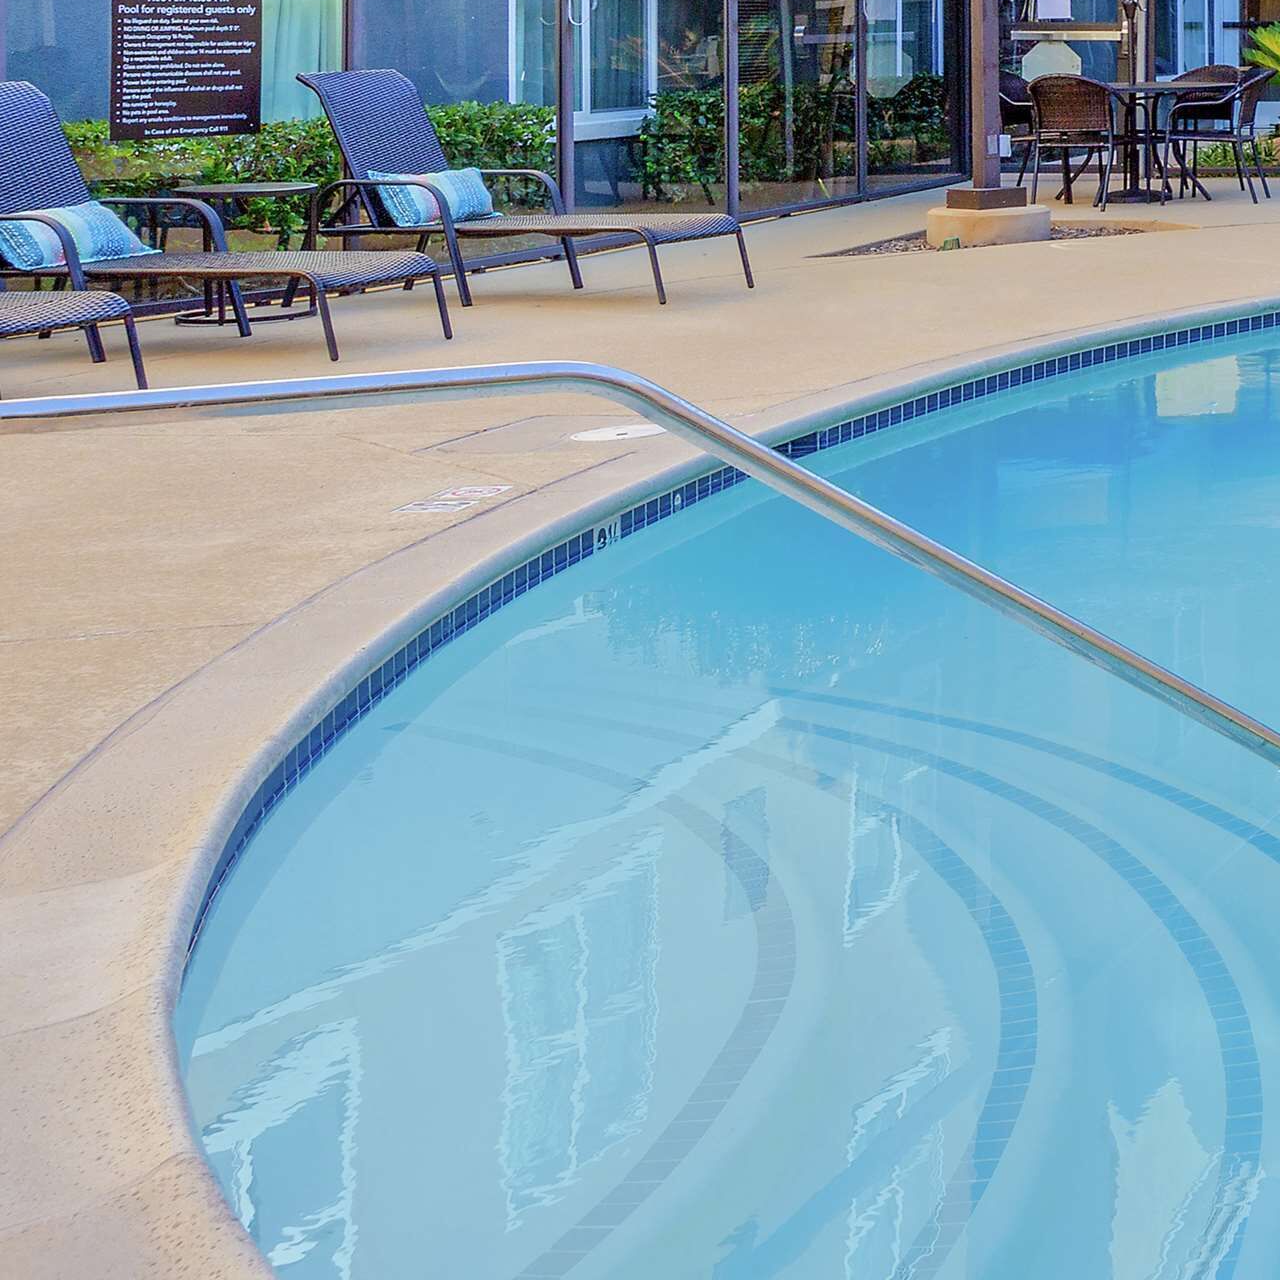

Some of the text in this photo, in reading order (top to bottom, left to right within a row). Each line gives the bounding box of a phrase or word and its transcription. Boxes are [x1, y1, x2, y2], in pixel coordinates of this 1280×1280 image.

[118, 4, 256, 16] Pool for registered guests only
